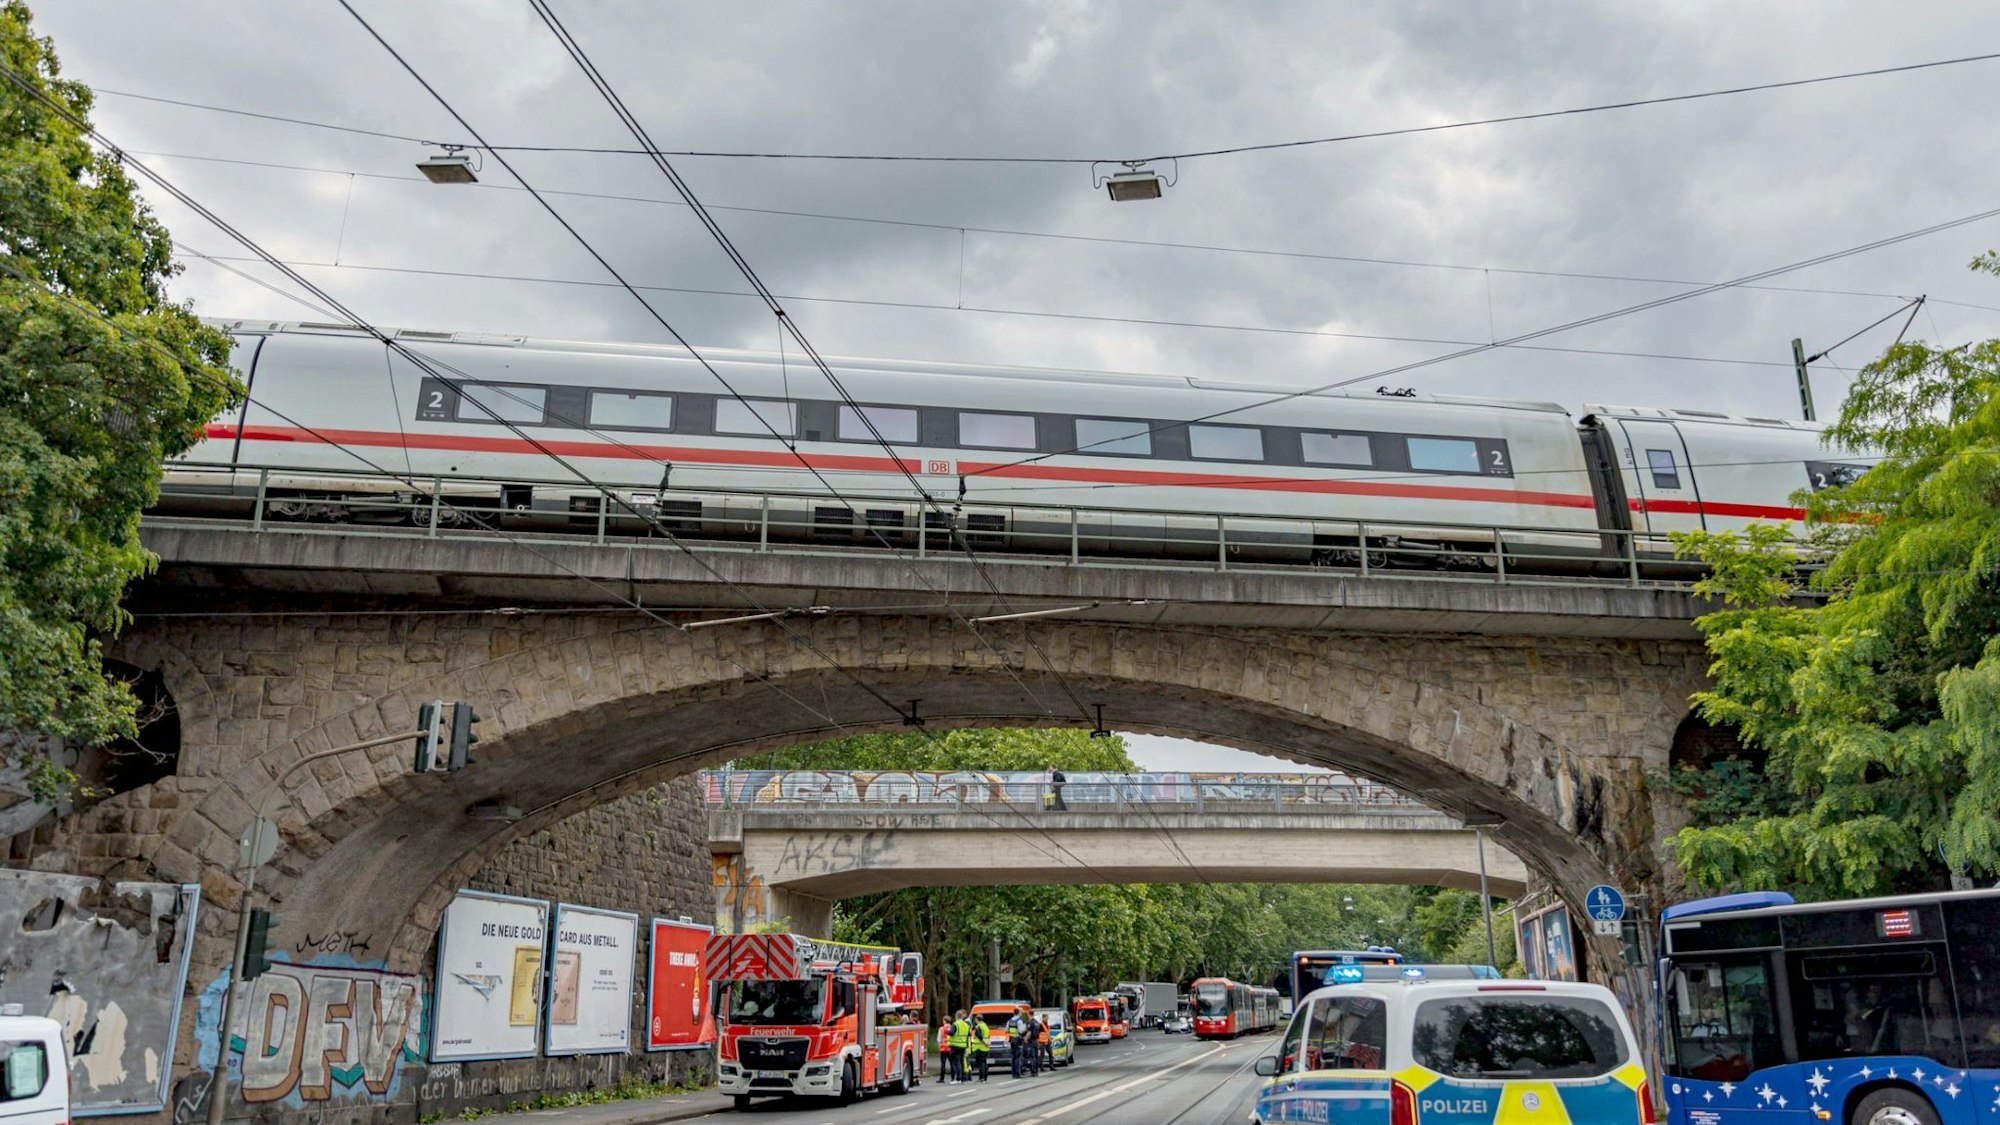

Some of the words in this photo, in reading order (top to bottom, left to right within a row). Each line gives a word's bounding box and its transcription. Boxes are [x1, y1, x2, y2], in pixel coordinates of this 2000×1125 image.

[429, 391, 443, 408] 2
[1491, 450, 1504, 466] 2
[931, 462, 947, 473] DB
[1815, 473, 1828, 488] 2
[855, 814, 903, 829] SLOW
[481, 922, 497, 937] DIE
[498, 924, 519, 939] NEUE
[521, 926, 542, 940] GOLD
[560, 930, 578, 944] CARD
[578, 932, 593, 946] AUS
[593, 934, 620, 948] METALL.
[750, 1026, 797, 1036] Feuerwehr
[1302, 1100, 1328, 1123] POLIZEI
[1422, 1099, 1488, 1114] POLIZEI
